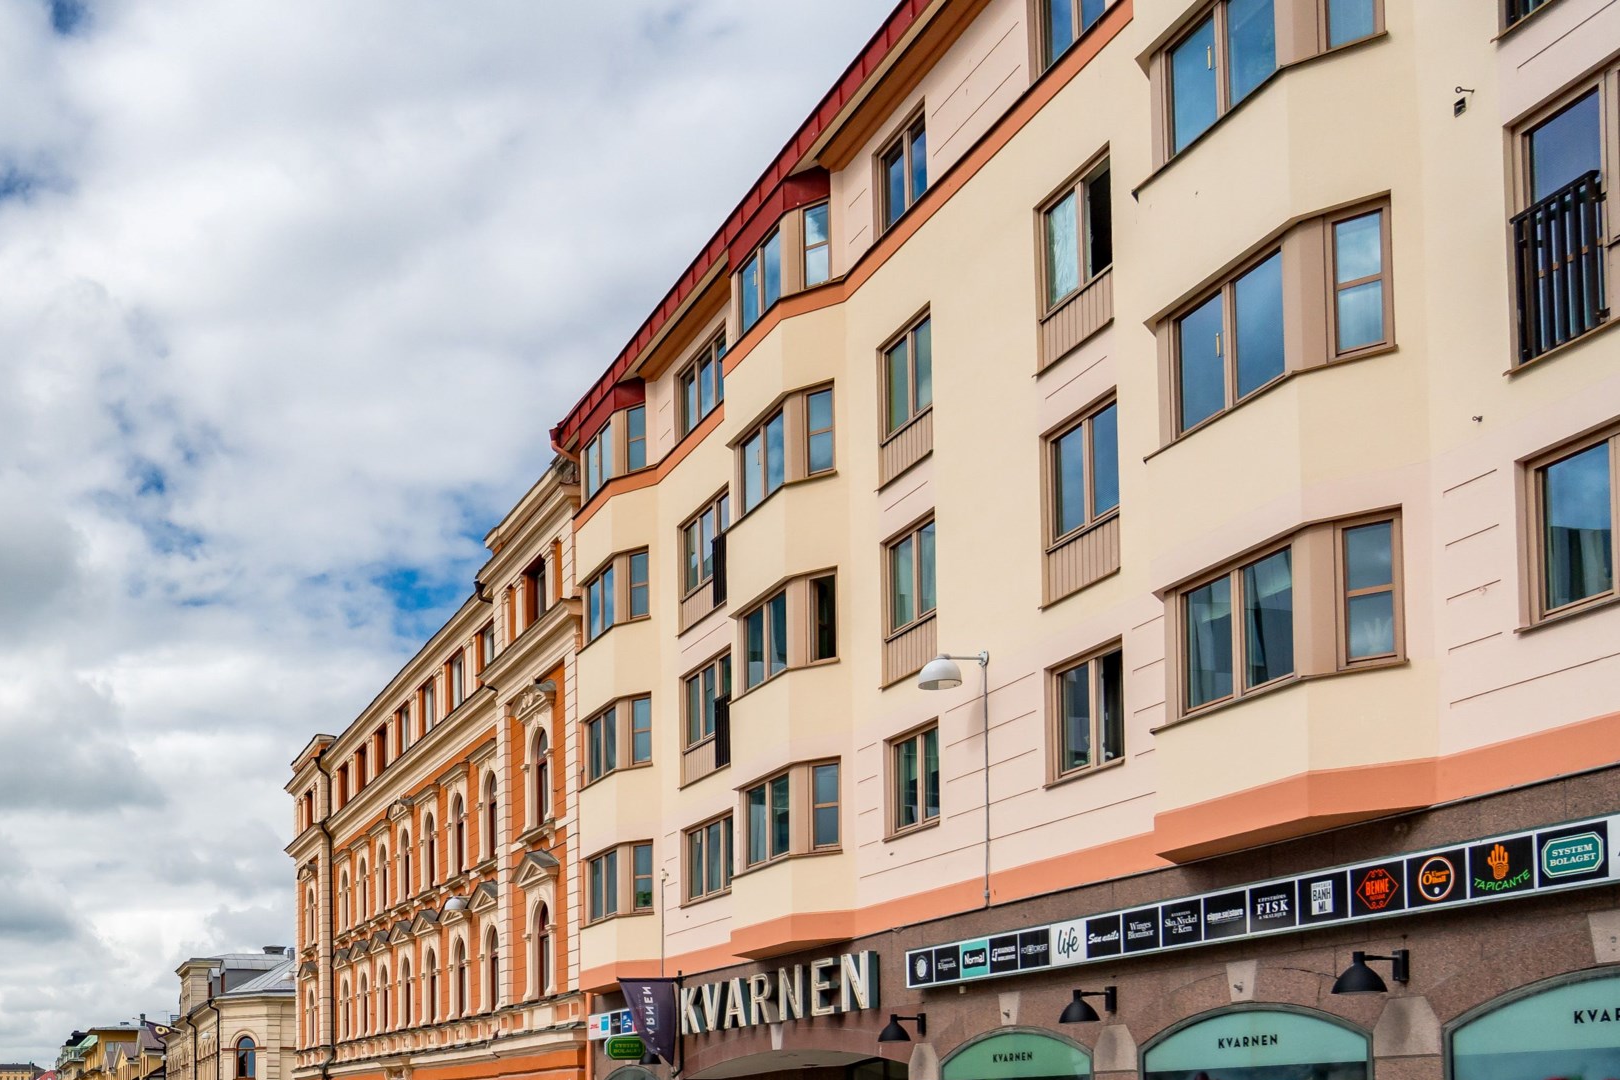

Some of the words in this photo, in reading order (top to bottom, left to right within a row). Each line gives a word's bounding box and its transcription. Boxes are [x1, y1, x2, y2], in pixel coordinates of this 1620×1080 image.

[1551, 843, 1593, 857] SYSTEM
[1549, 852, 1597, 867] BOLAGET
[1365, 878, 1390, 896] BENNE
[1474, 869, 1530, 891] TAPICANTE
[1312, 887, 1331, 901] BANH
[1256, 899, 1289, 915] FISK
[1129, 921, 1152, 932] Winges
[1057, 927, 1080, 958] life
[1103, 930, 1119, 942] nails
[964, 951, 986, 966] Normal
[680, 950, 878, 1034] KVARNEN
[1218, 1033, 1278, 1049] KVARNEN
[992, 1051, 1033, 1063] KVARNEN
